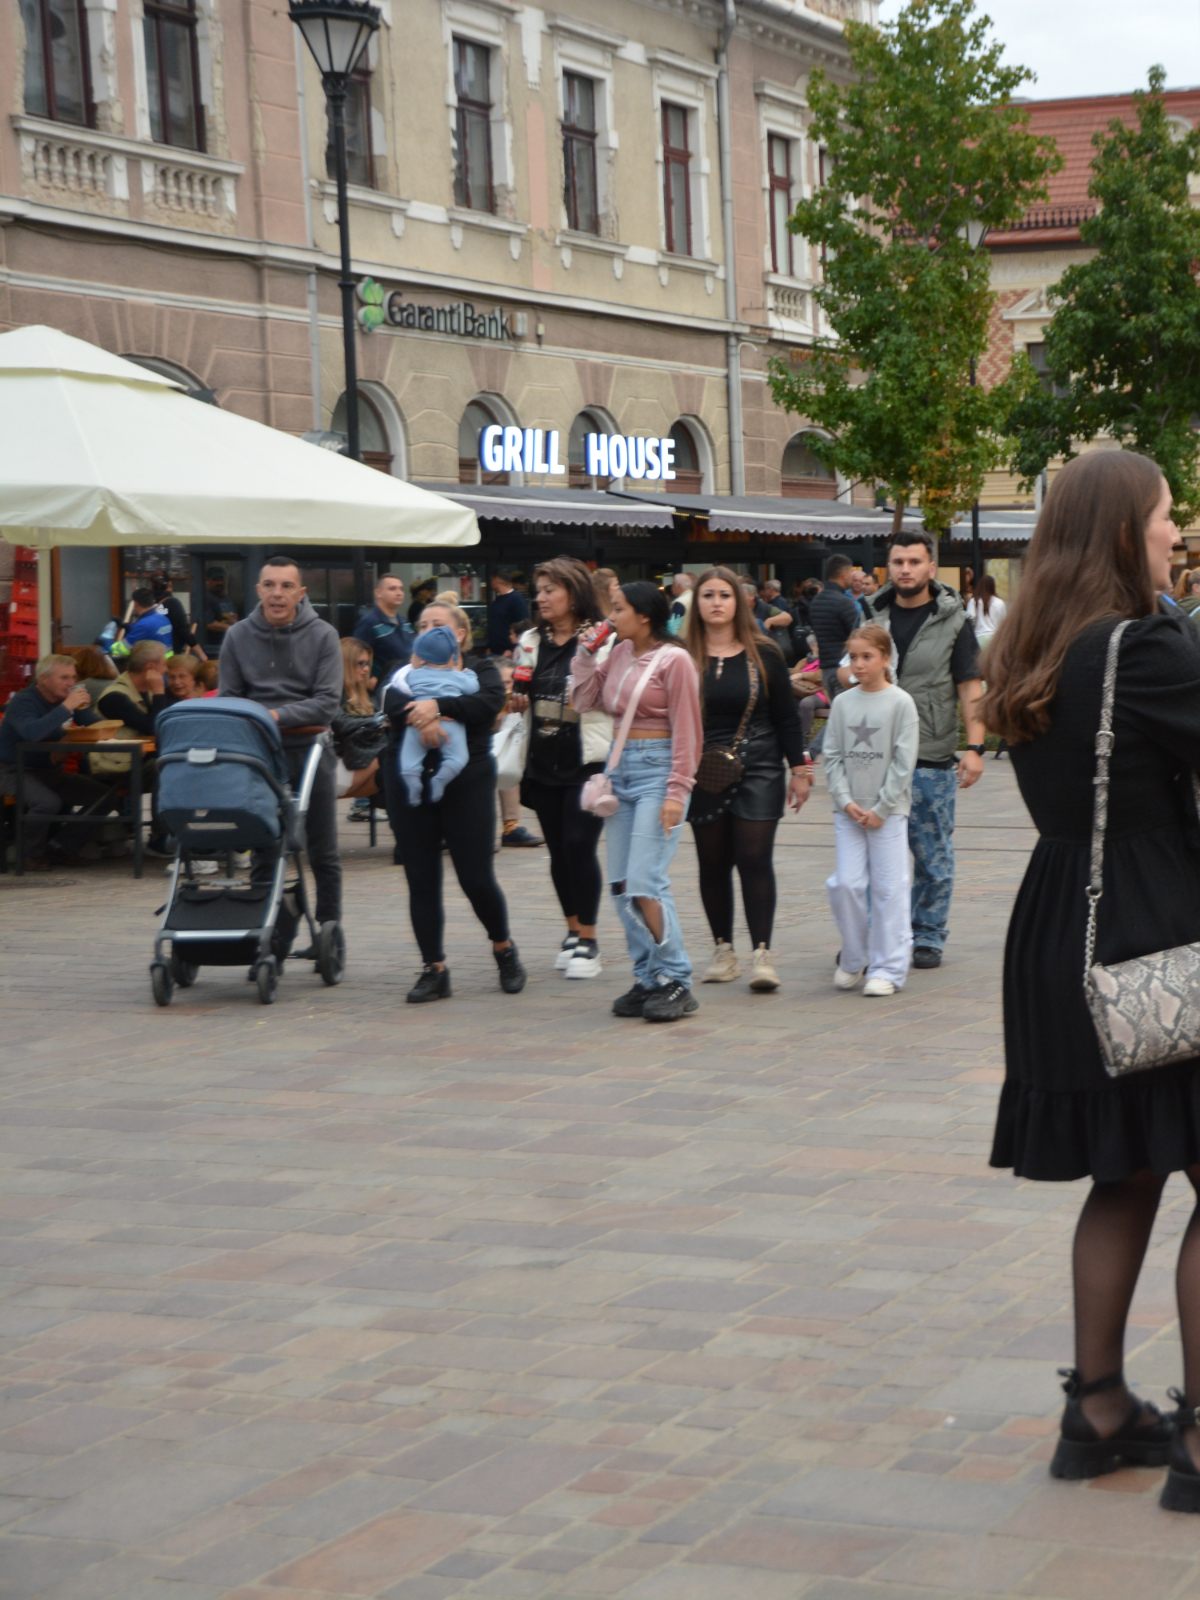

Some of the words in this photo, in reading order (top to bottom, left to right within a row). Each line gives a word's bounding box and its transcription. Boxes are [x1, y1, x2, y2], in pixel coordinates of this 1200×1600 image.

[383, 291, 511, 340] GarantiBank
[480, 424, 565, 475] GRILL
[586, 432, 676, 480] HOUSE
[844, 751, 884, 759] LONDON
